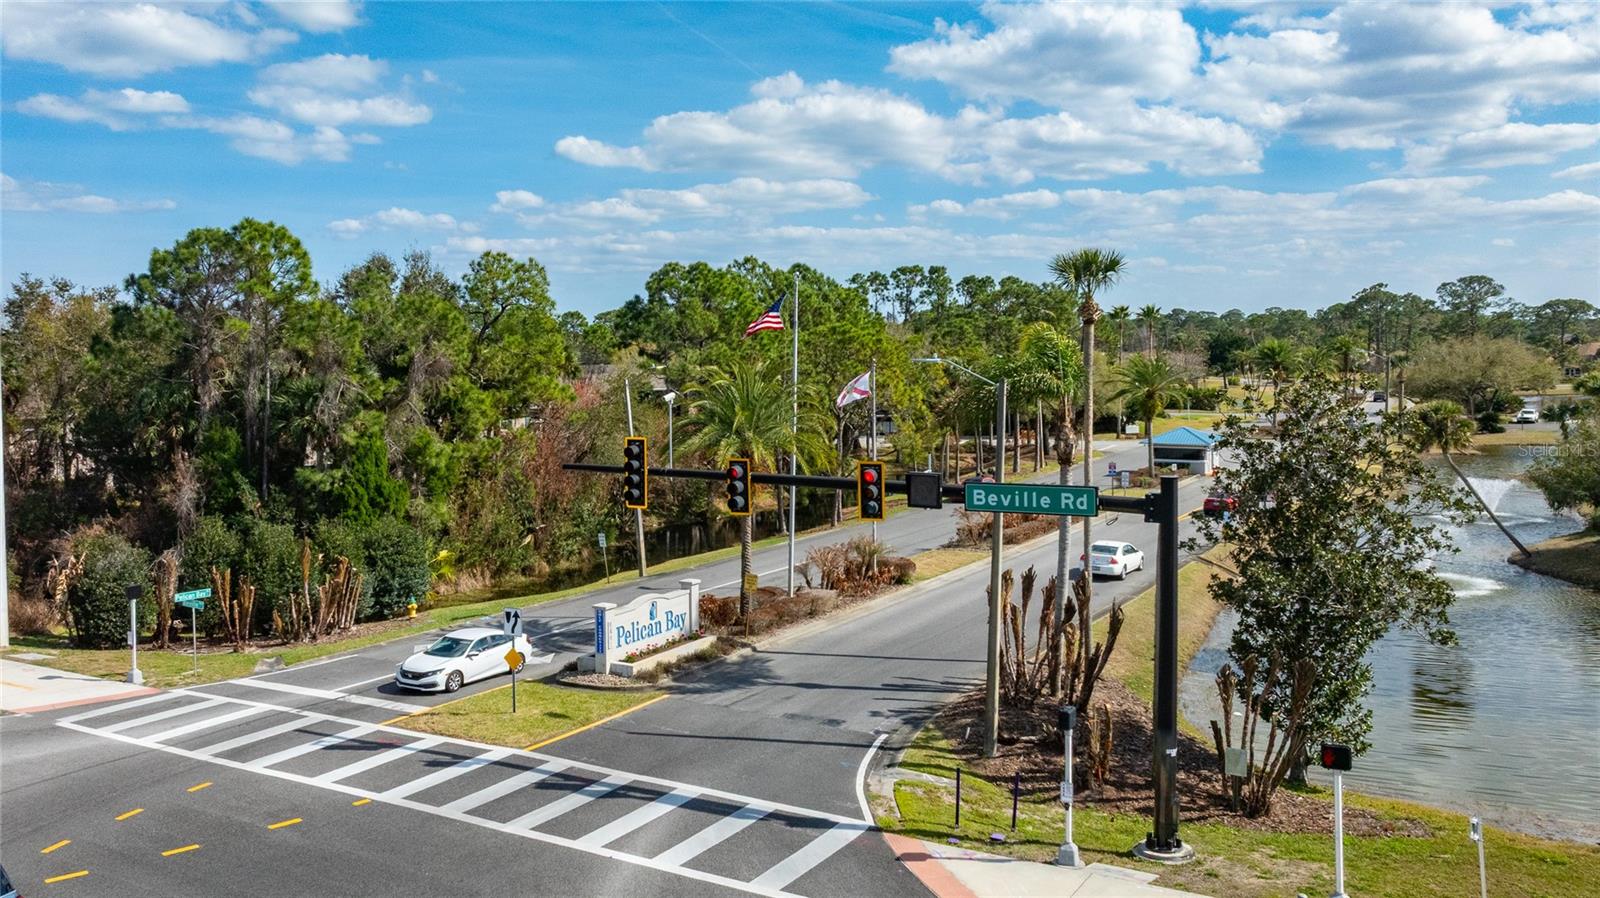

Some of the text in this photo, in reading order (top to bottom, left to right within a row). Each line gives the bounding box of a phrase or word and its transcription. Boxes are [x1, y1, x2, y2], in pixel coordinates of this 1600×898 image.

[973, 489, 1088, 510] Beville Rd
[616, 620, 662, 648] Pelican
[665, 610, 687, 632] Bay
